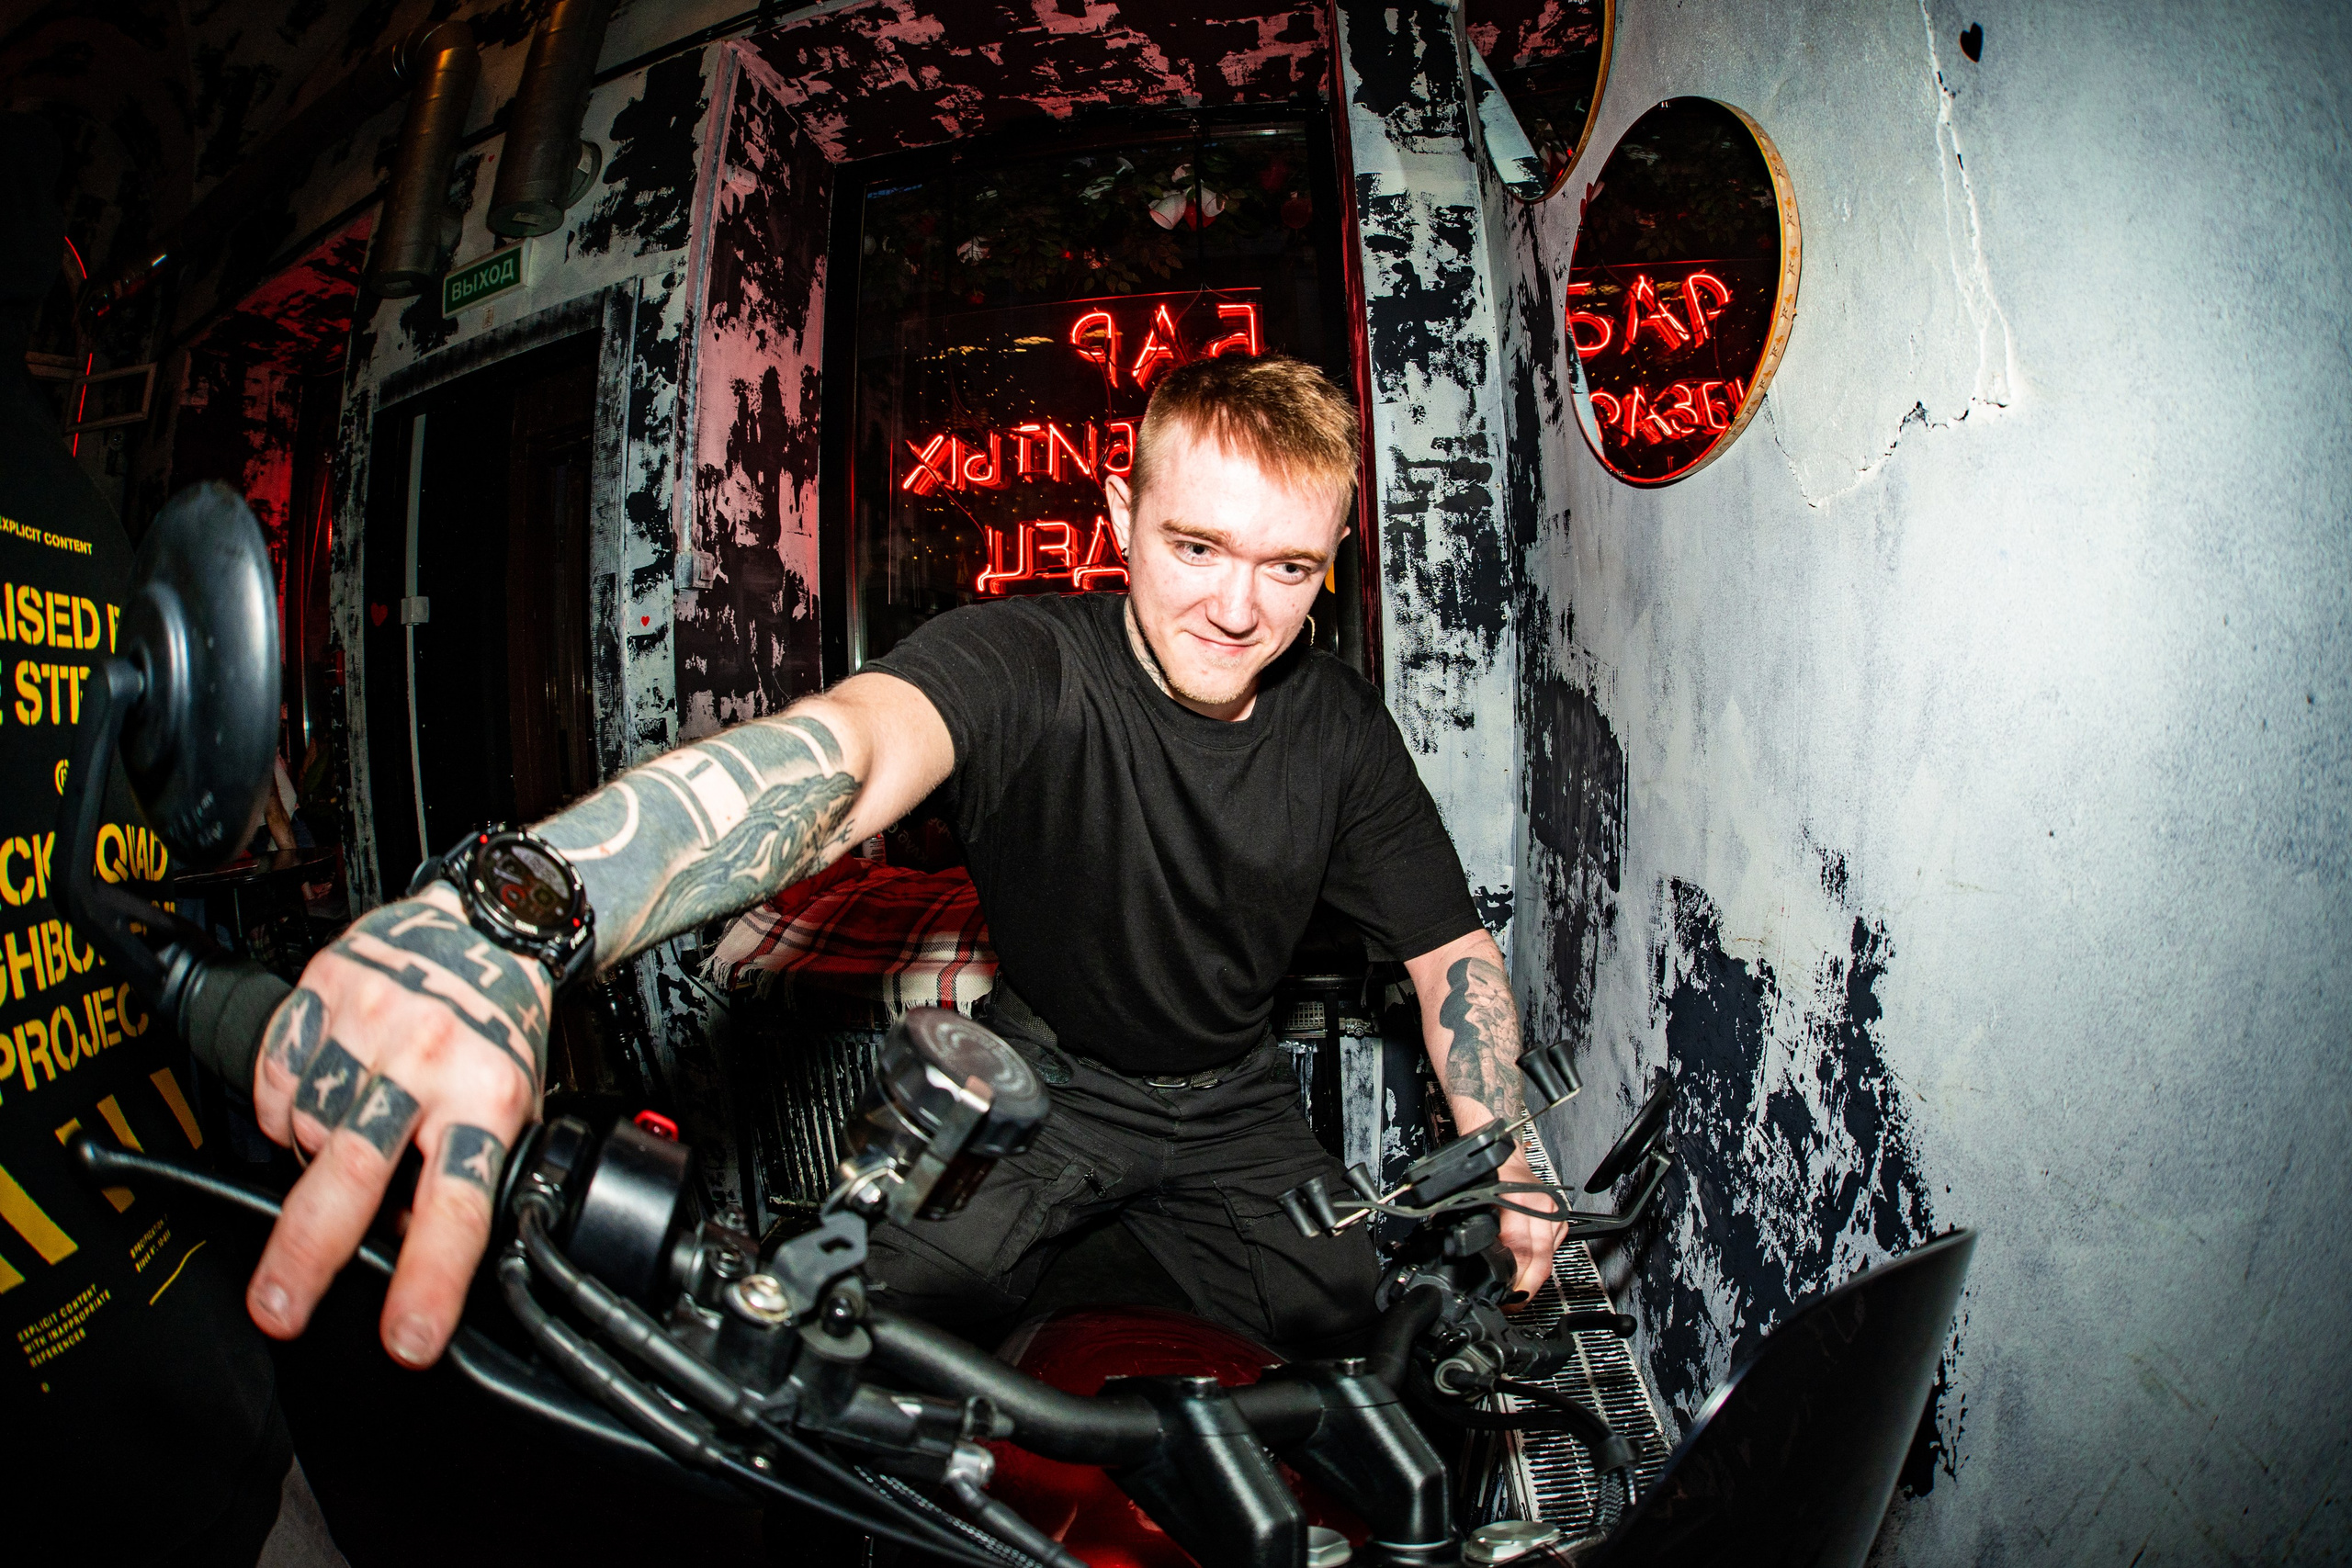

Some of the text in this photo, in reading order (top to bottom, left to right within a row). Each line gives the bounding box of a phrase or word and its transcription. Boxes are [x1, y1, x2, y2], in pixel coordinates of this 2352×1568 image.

[451, 258, 514, 301] ВЫХОД
[1589, 377, 1745, 446] РАЗБ
[43, 532, 93, 555] CONTENT
[0, 982, 149, 1091] PROJEC
[17, 1283, 97, 1343] EXPLICIT CONTENT
[23, 1289, 111, 1355] WITH INAPPROPRIATE
